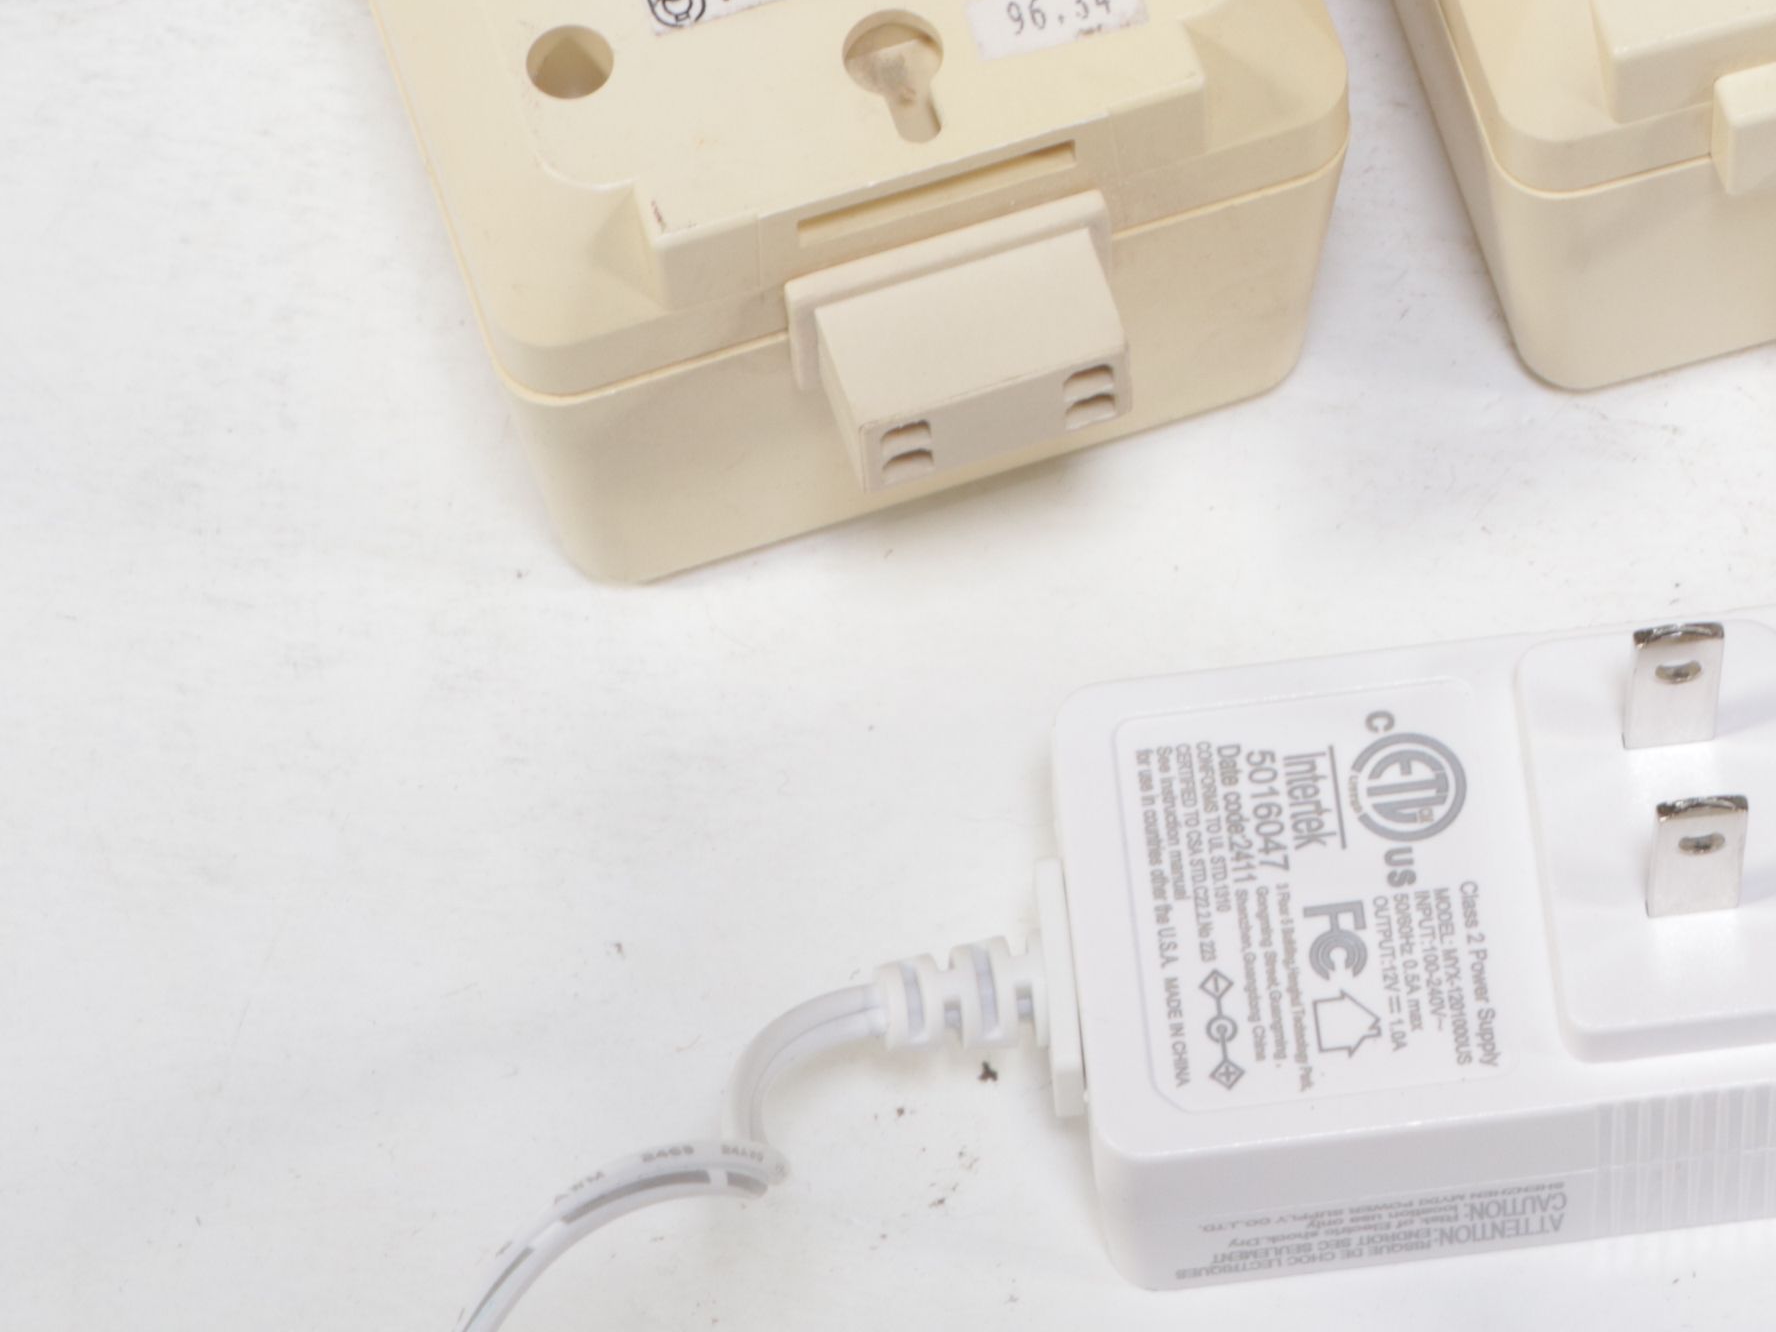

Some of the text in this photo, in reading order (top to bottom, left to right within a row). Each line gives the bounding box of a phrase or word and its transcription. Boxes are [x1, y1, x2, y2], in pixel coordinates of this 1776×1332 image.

[1136, 749, 1153, 766] for
[1176, 745, 1197, 807] CERTIFIED
[1138, 770, 1153, 792] use
[1196, 743, 1219, 813] CONFORMS
[1142, 795, 1155, 806] in
[1217, 744, 1256, 882] Date code:2411
[1246, 751, 1290, 871] 5016047
[1284, 752, 1336, 850] Intertek
[1144, 810, 1162, 866] countries
[1156, 747, 1190, 900] See instruction manual
[1185, 811, 1201, 834] TO
[1206, 816, 1222, 837] TO
[1186, 832, 1202, 860] CSA
[1208, 836, 1224, 854] UL
[1151, 869, 1169, 900] other
[1155, 904, 1172, 924] the
[1434, 888, 1454, 943] MODEL:
[1393, 894, 1422, 1031] 50/60Hz 0.5A max
[1459, 881, 1500, 1066] Class 2 Power Supply
[1165, 978, 1182, 1018] MADE
[1170, 1023, 1184, 1037] IN
[1252, 1025, 1266, 1061] China
[1390, 1019, 1407, 1051] 1.0A
[1172, 1041, 1190, 1086] CHINA
